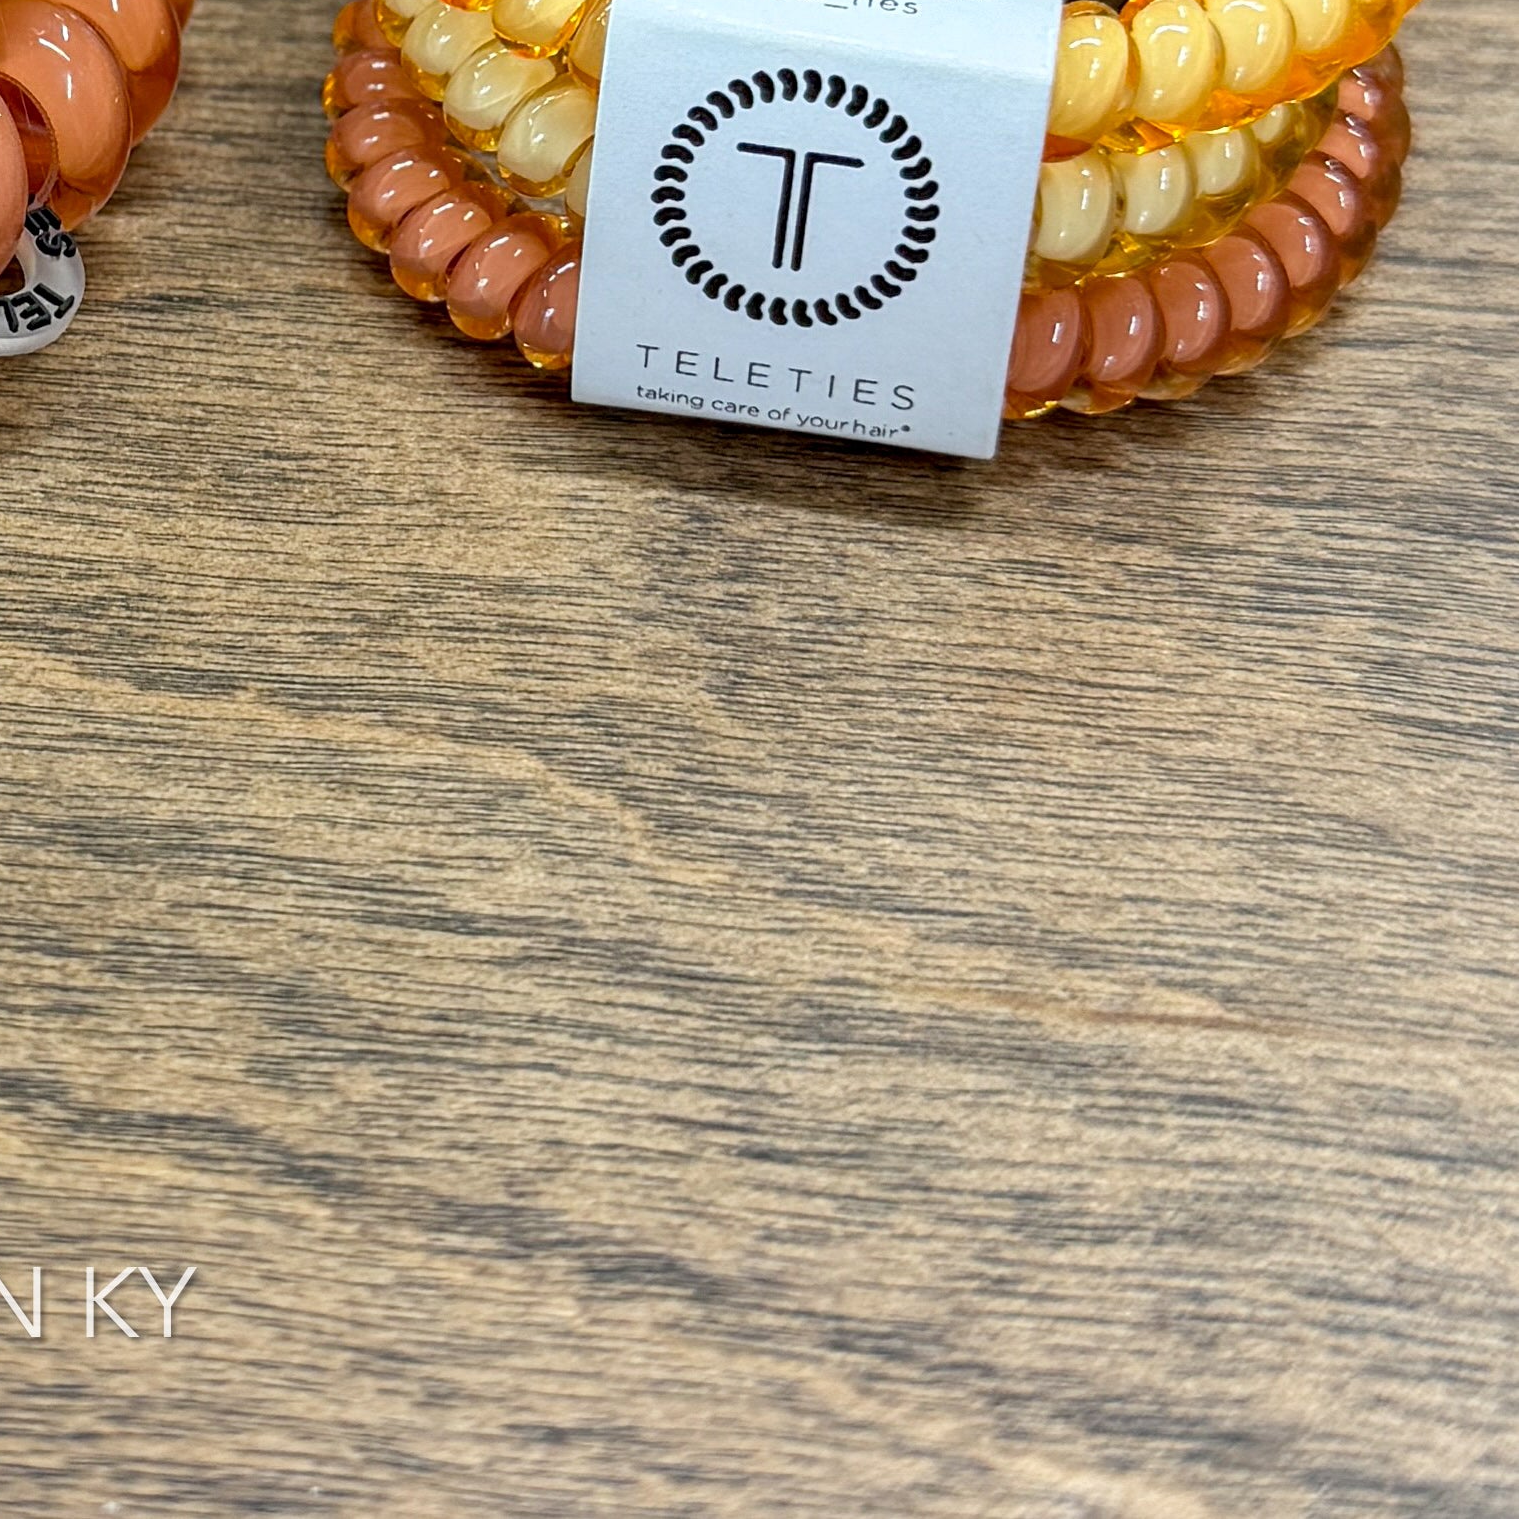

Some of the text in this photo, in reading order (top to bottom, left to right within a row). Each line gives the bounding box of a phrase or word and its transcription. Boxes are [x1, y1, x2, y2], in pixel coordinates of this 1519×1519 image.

[736, 141, 866, 272] T
[635, 343, 916, 411] TELETIES
[635, 384, 705, 410] taking
[711, 398, 761, 418] care
[767, 406, 792, 421] of
